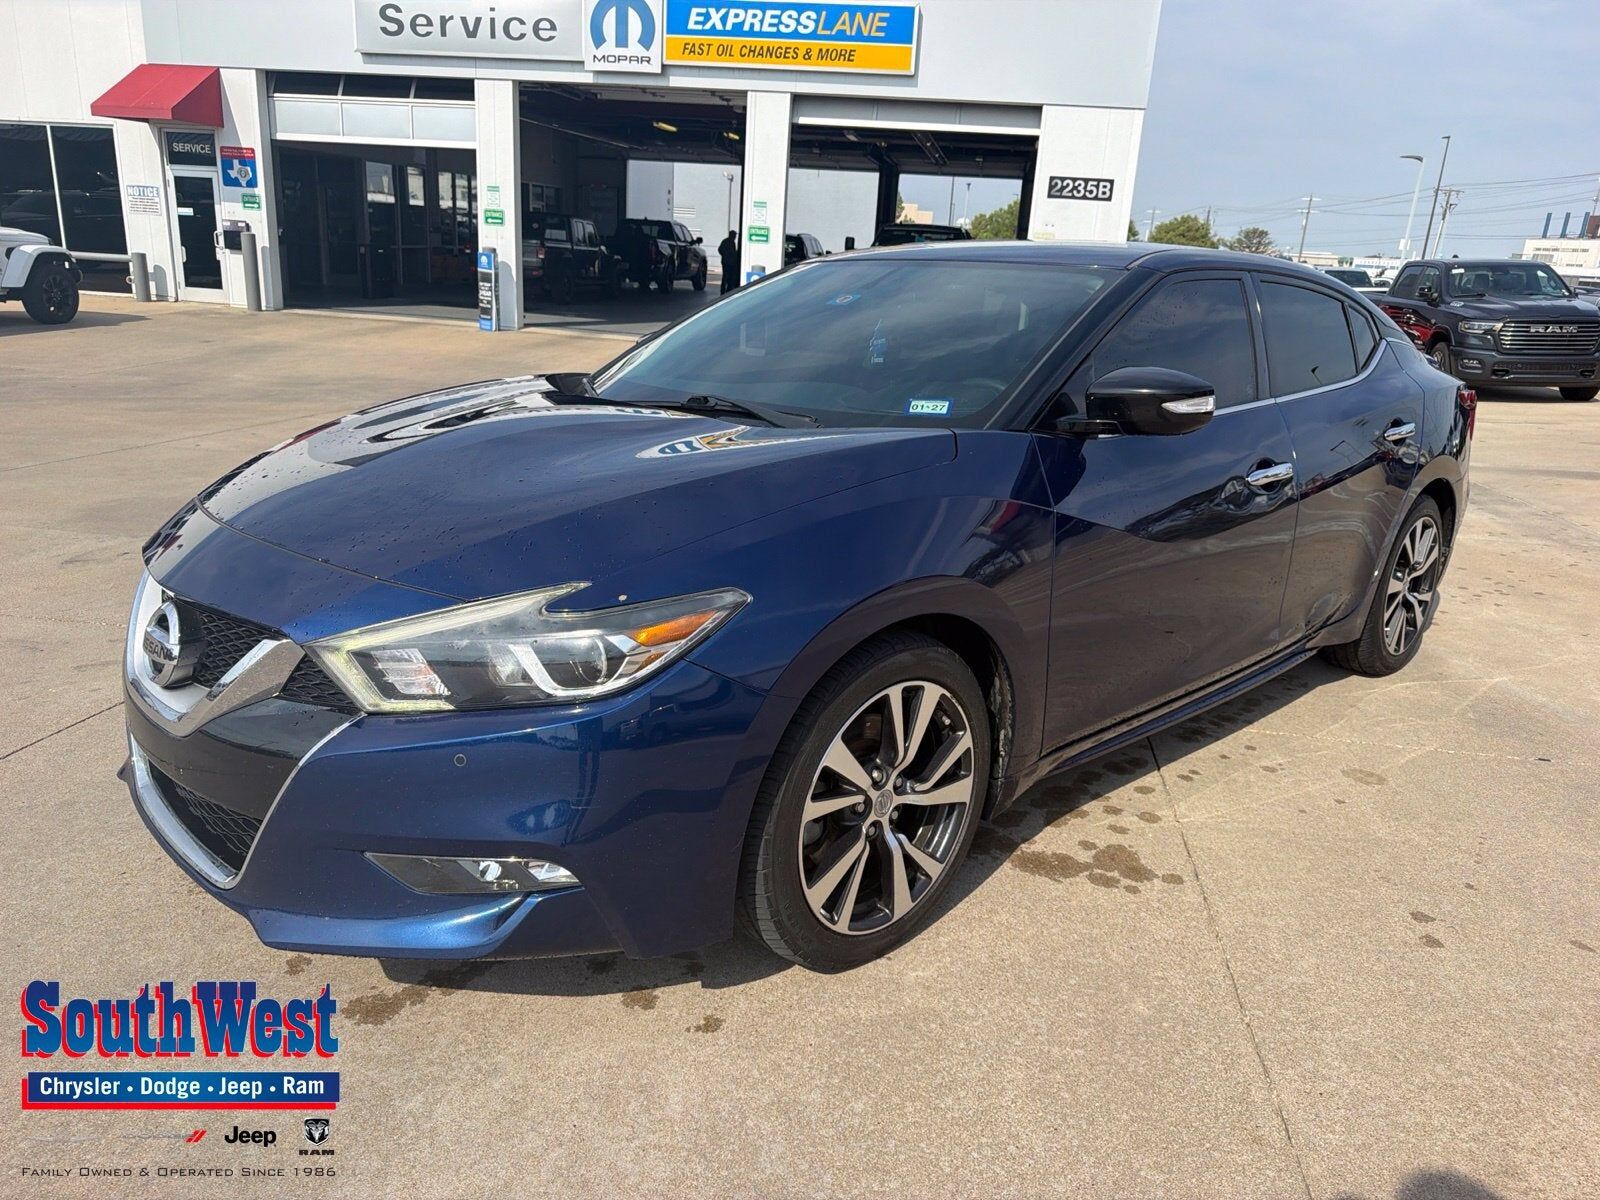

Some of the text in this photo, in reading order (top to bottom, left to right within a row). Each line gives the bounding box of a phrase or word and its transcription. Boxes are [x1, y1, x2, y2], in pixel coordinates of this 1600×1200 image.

[378, 3, 558, 42] Service
[682, 42, 856, 62] FAST OIL CHANGES & MORE
[592, 54, 652, 65] MOPAR
[172, 142, 212, 154] SERVICE
[127, 186, 159, 197] NOTICE
[1050, 179, 1112, 198] 2235B
[1530, 325, 1578, 333] RAM
